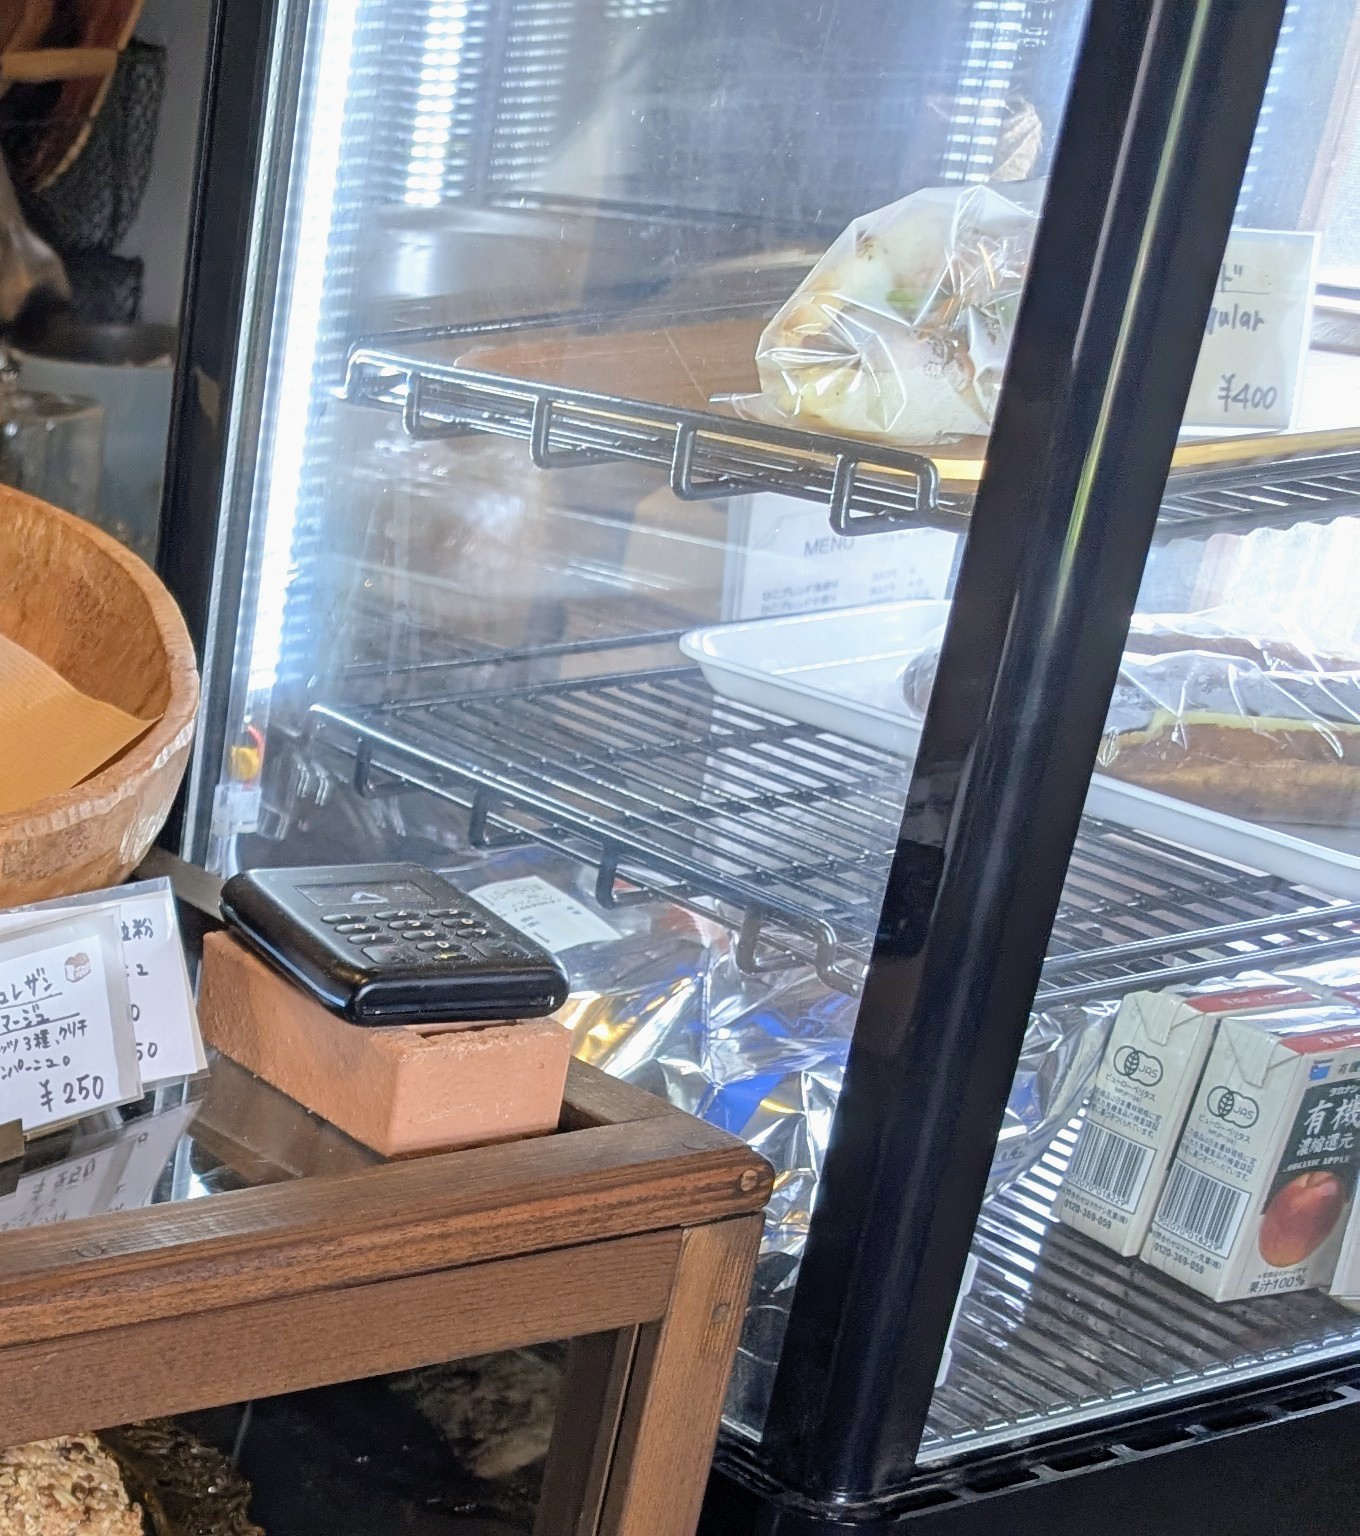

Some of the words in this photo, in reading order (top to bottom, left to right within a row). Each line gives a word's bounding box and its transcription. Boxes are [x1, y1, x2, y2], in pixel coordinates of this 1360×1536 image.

[1217, 372, 1278, 413] ¥400
[803, 536, 855, 558] MENU
[1137, 1065, 1159, 1080] JAS
[40, 1074, 105, 1113] ¥250
[1233, 1106, 1254, 1120] JAS
[1295, 1132, 1354, 1157] 濃縮還元
[1322, 1154, 1351, 1166] APPLE
[1247, 1274, 1306, 1294] 果汁100%
